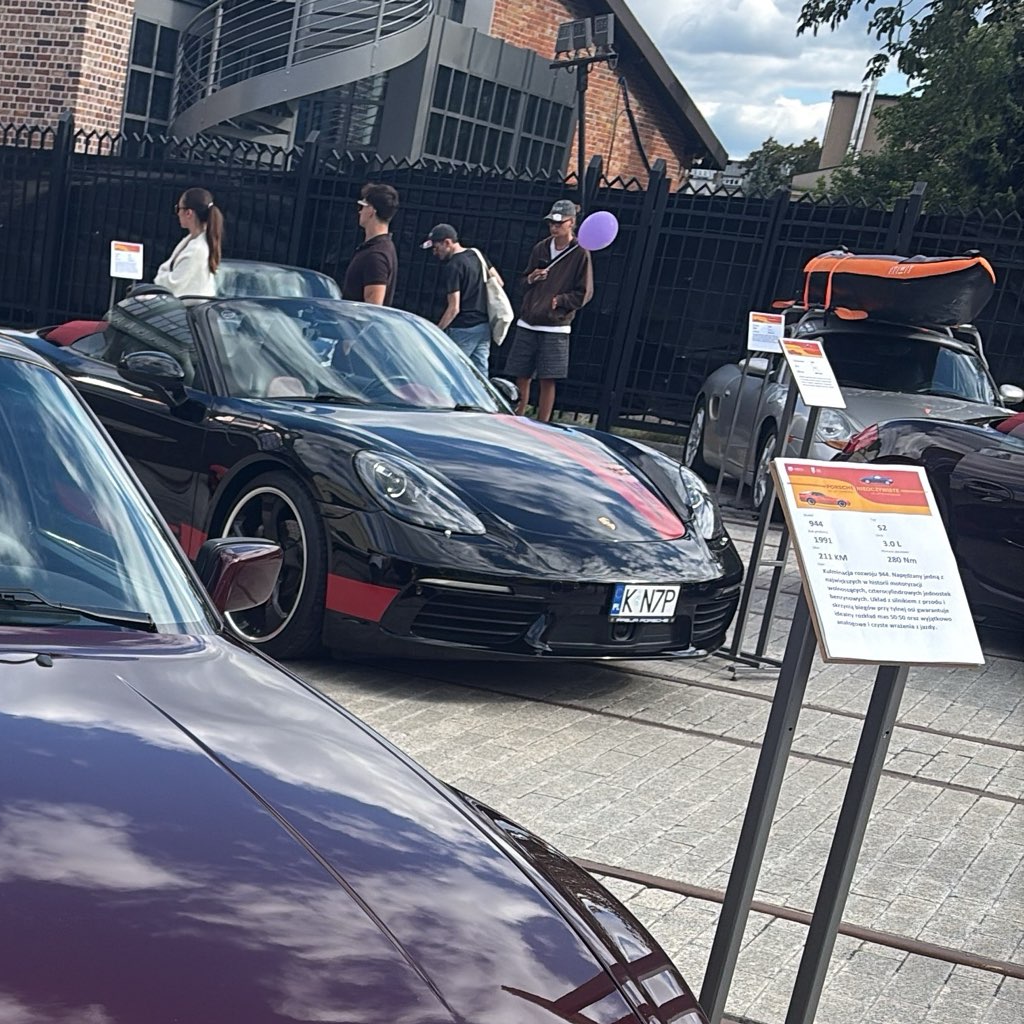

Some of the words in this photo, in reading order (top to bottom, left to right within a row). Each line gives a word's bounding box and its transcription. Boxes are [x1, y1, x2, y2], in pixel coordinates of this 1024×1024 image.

[808, 520, 824, 528] 944
[876, 524, 888, 532] S2
[813, 536, 833, 544] 1991
[882, 540, 896, 548] 3.0
[817, 552, 833, 560] 211
[886, 556, 902, 564] 280
[902, 557, 917, 565] Nm
[621, 589, 638, 613] K
[639, 588, 677, 613] N7P
